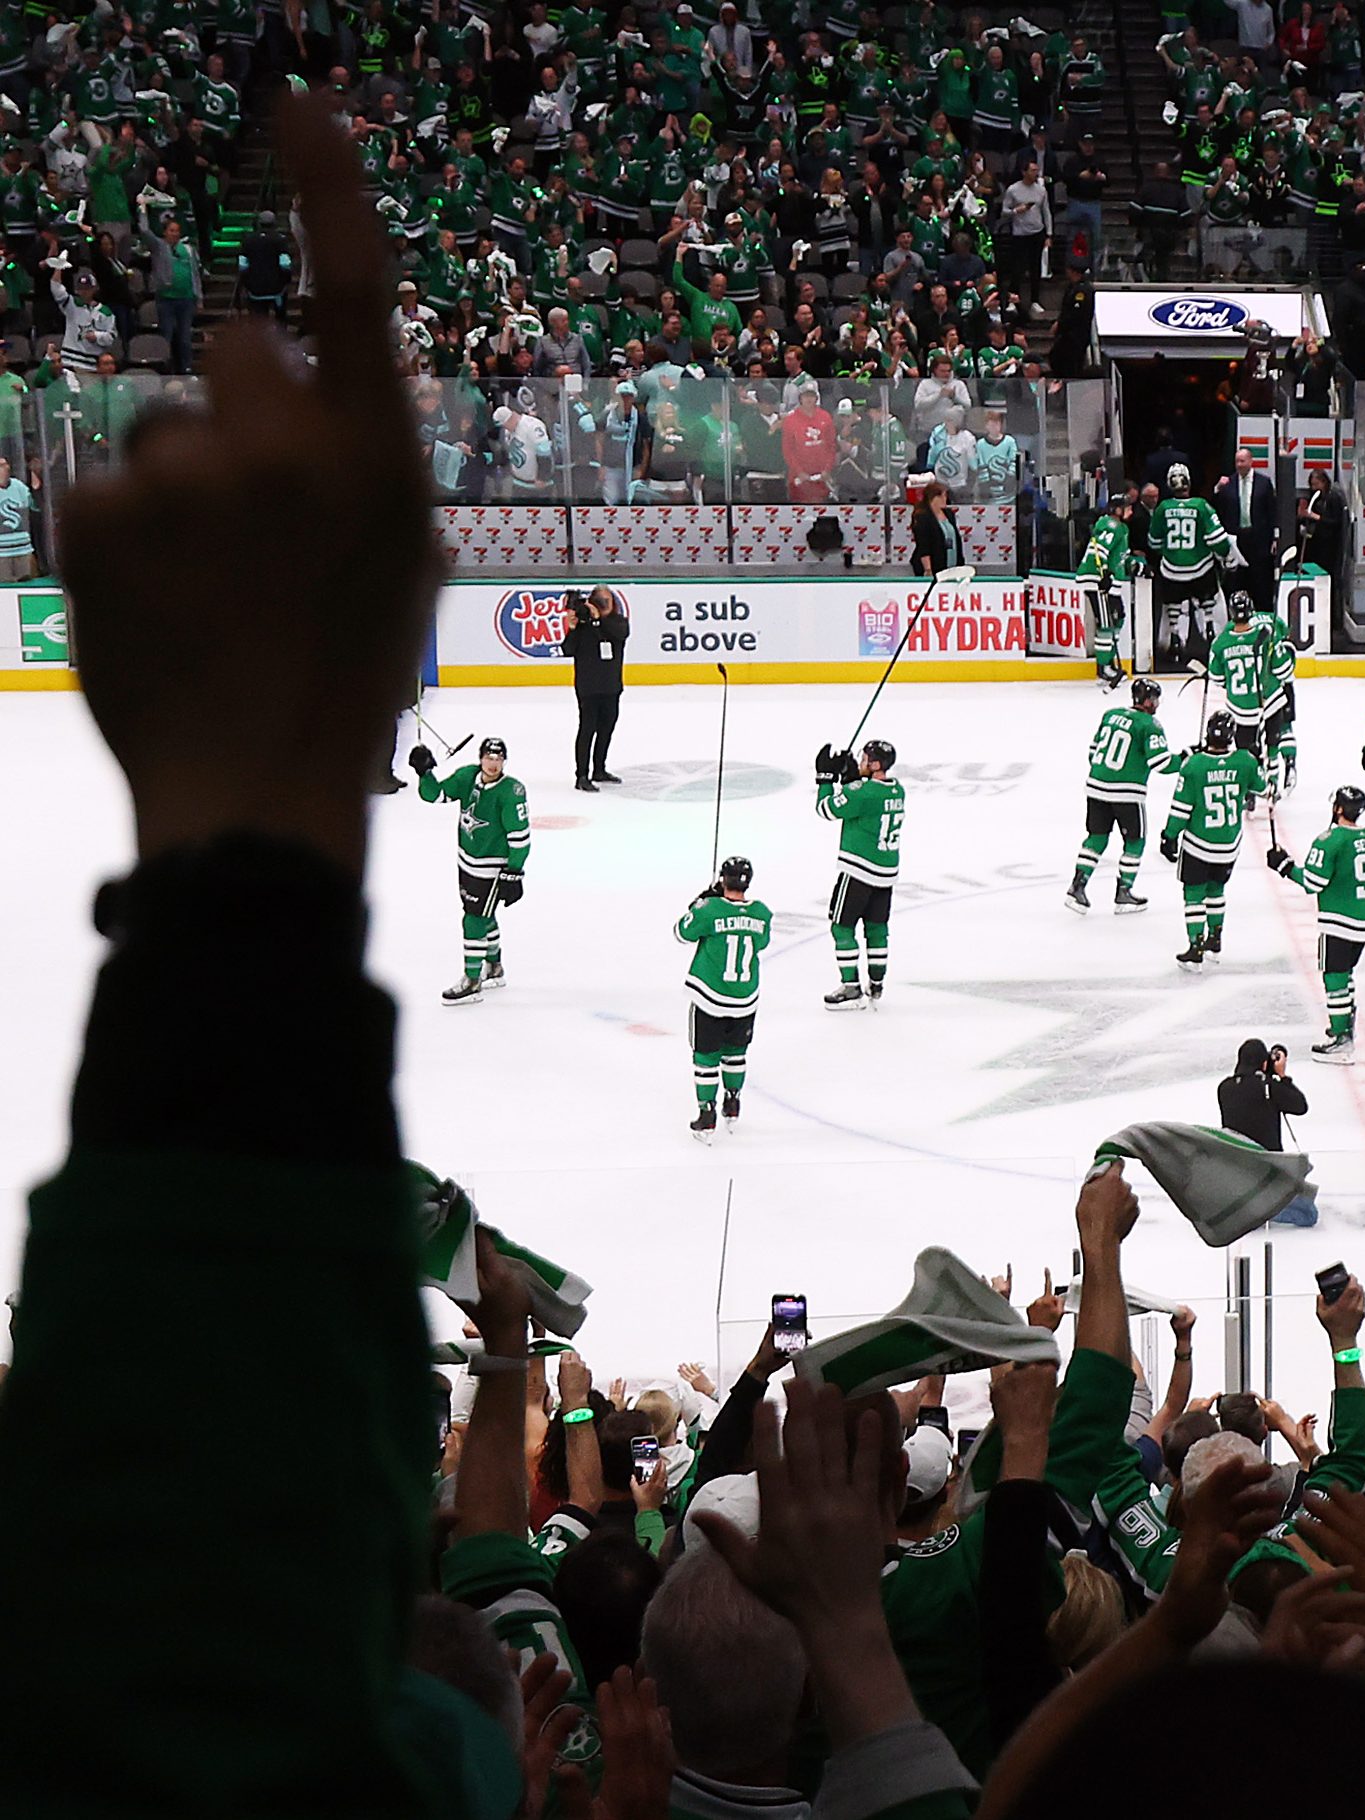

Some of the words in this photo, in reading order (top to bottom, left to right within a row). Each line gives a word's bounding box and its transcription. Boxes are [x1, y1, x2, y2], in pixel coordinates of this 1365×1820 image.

[1167, 300, 1231, 327] Ford
[1166, 518, 1197, 549] 29
[664, 601, 683, 621] a
[695, 594, 751, 621] sub
[864, 613, 894, 627] BIO
[660, 626, 757, 652] above
[1091, 726, 1132, 771] 20
[1203, 783, 1240, 829] 55
[1307, 848, 1324, 868] 91
[722, 934, 755, 983] 11
